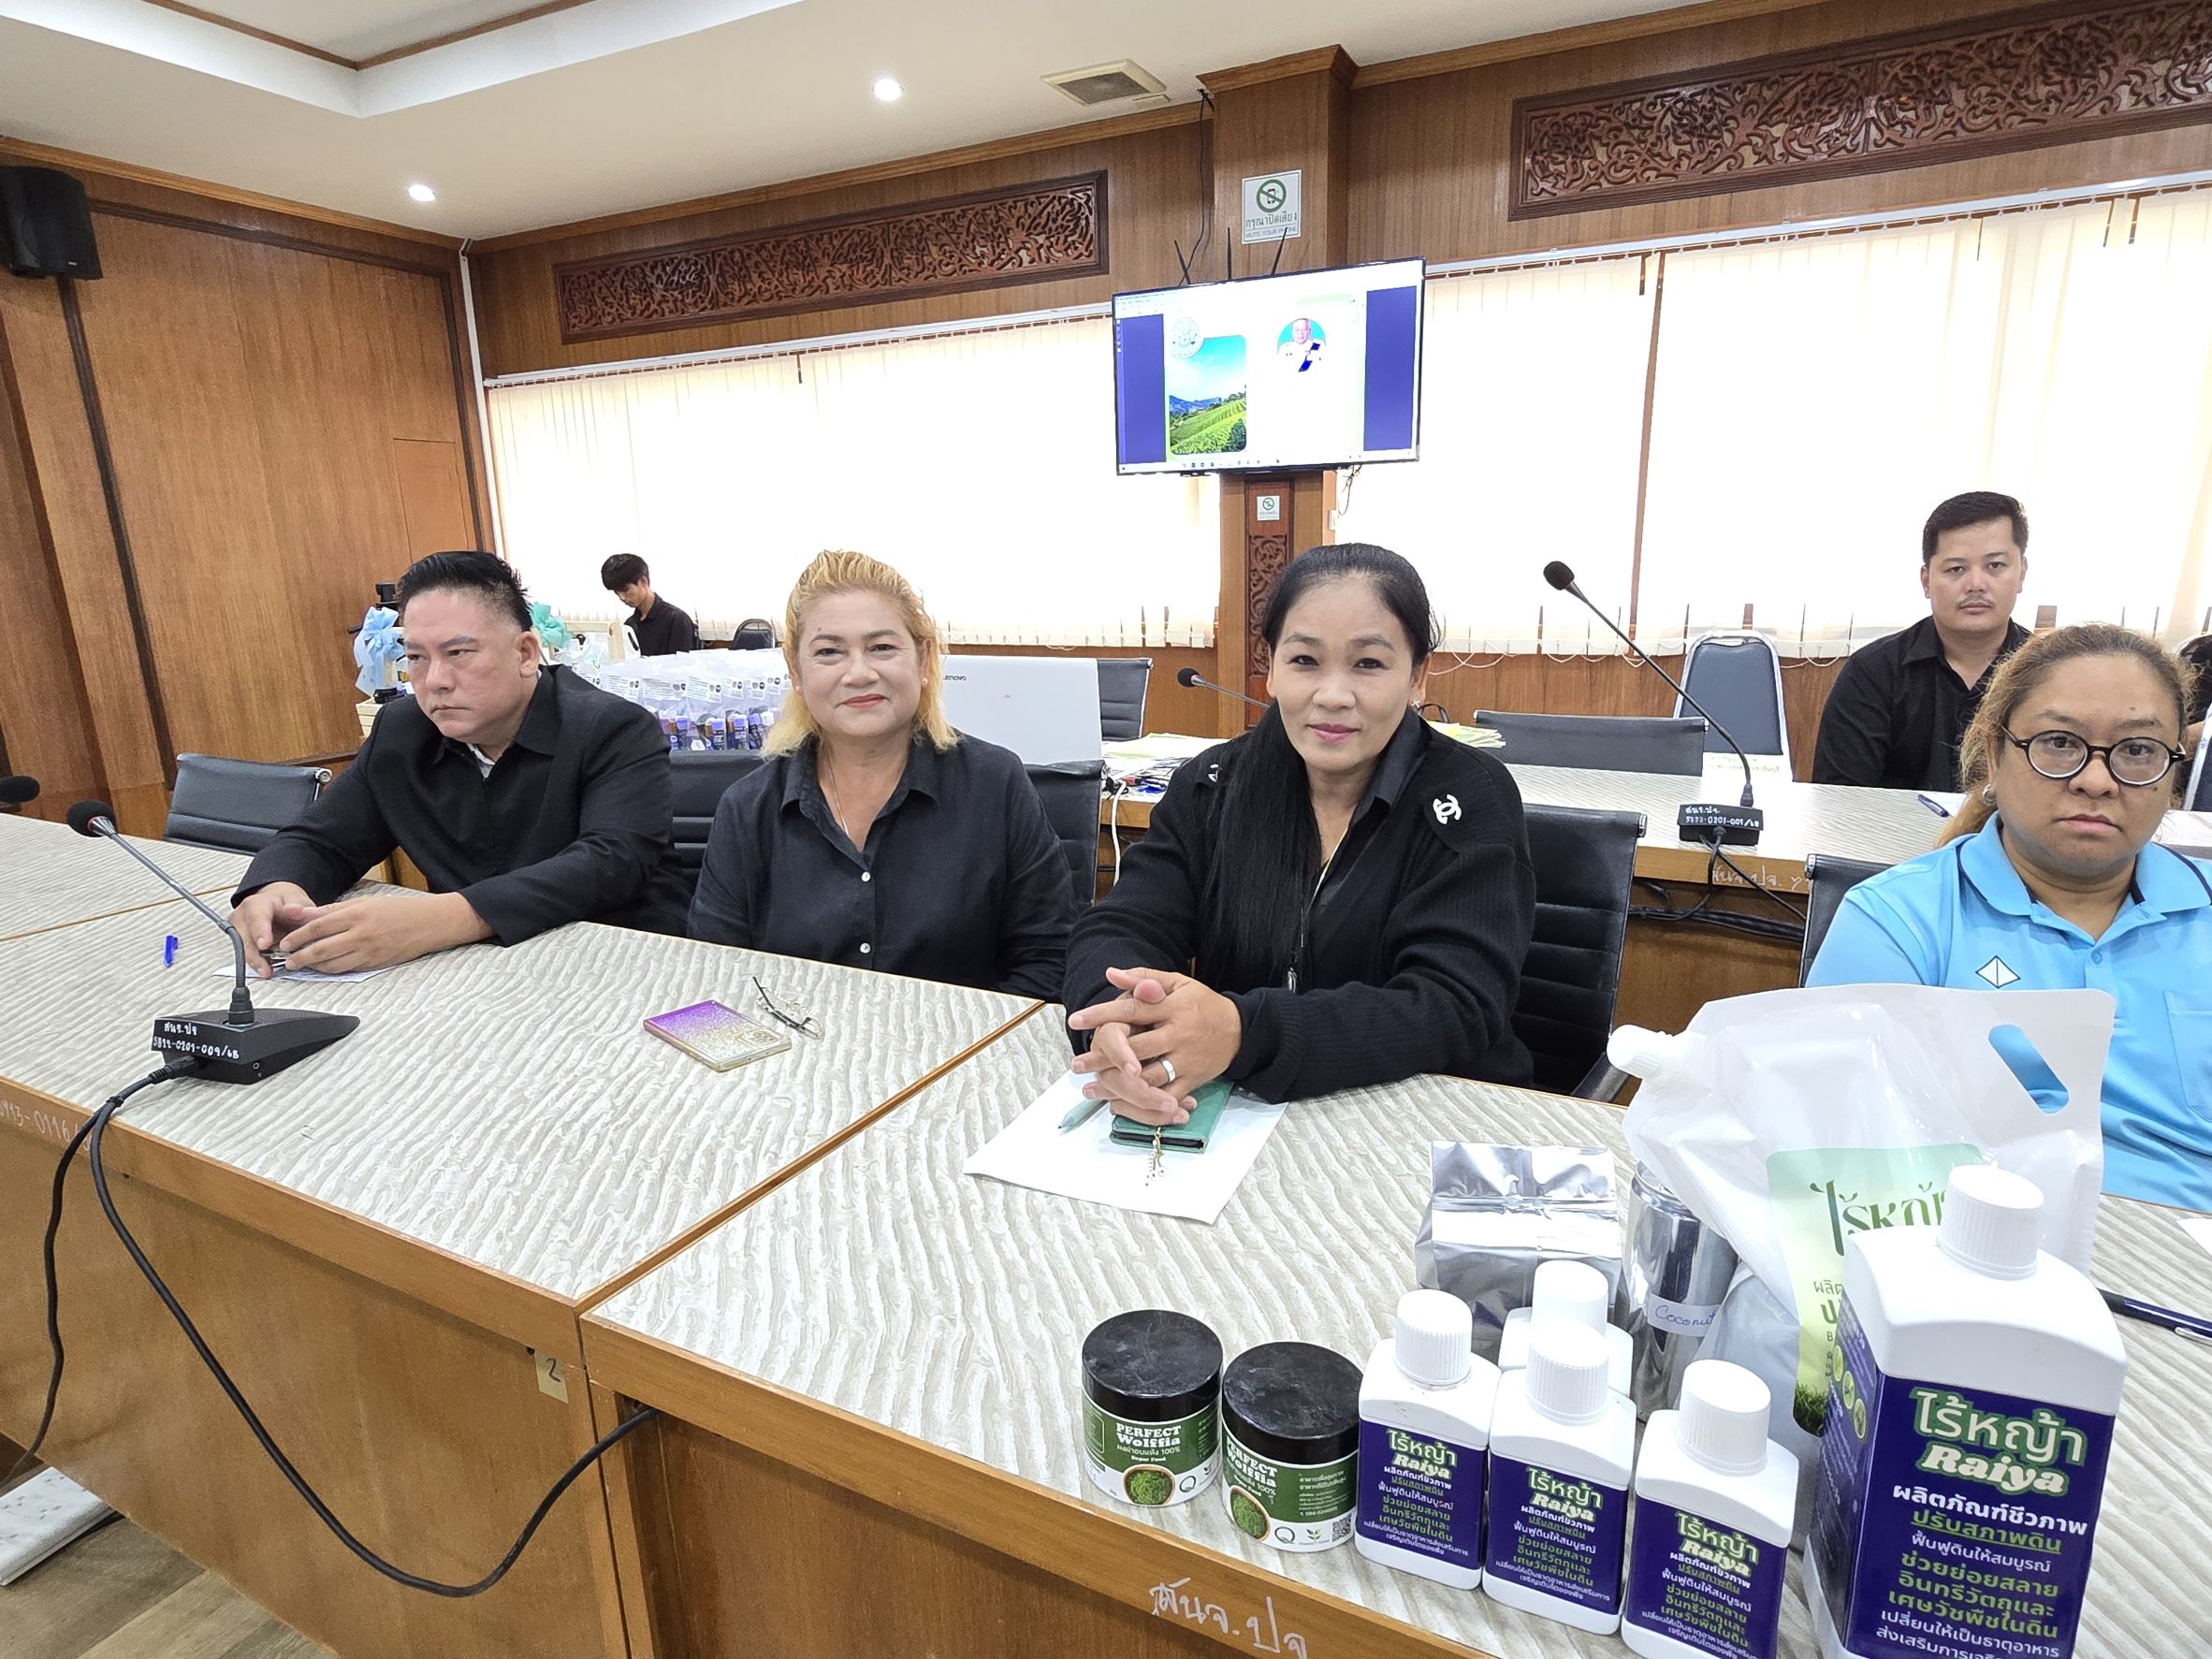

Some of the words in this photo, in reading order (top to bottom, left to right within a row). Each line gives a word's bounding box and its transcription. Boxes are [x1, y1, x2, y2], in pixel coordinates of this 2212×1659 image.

[1245, 211, 1298, 229] กรุณาปิดเสียง
[1654, 1304, 1717, 1326] Coconut
[546, 1357, 561, 1383] 2
[1115, 1422, 1182, 1437] PERFECT
[1116, 1433, 1181, 1448] Wolffia
[1387, 1429, 1457, 1466] ไร้หญ้า
[1914, 1390, 2086, 1463] ไร้หญ้า
[1161, 1446, 1181, 1455] 100%
[1227, 1434, 1278, 1477] PERFECT
[1227, 1445, 1277, 1488] Wolffia
[1391, 1452, 1451, 1479] Raiya
[1921, 1443, 2066, 1493] Raiya
[1527, 1467, 1603, 1508] ไร้หญ้า
[1531, 1492, 1595, 1521] Raiya
[1893, 1483, 2088, 1535] ผลิตภัณฑ์ชีวภาพ
[1677, 1512, 1758, 1564] ไร้หญ้า
[1911, 1509, 2061, 1553] ปรับสภาพดิน
[1912, 1530, 2052, 1573] ฟื้นฟูดินให้สมบูรณ์
[1681, 1539, 1751, 1576] Raiya
[1900, 1550, 2059, 1598] ช่วยย่อยสลาย
[1881, 1608, 2060, 1658] เปลี่ยนให้เป็นธาตุอาหาร
[1888, 1589, 2059, 1638] เศษวัชพืชในดิน
